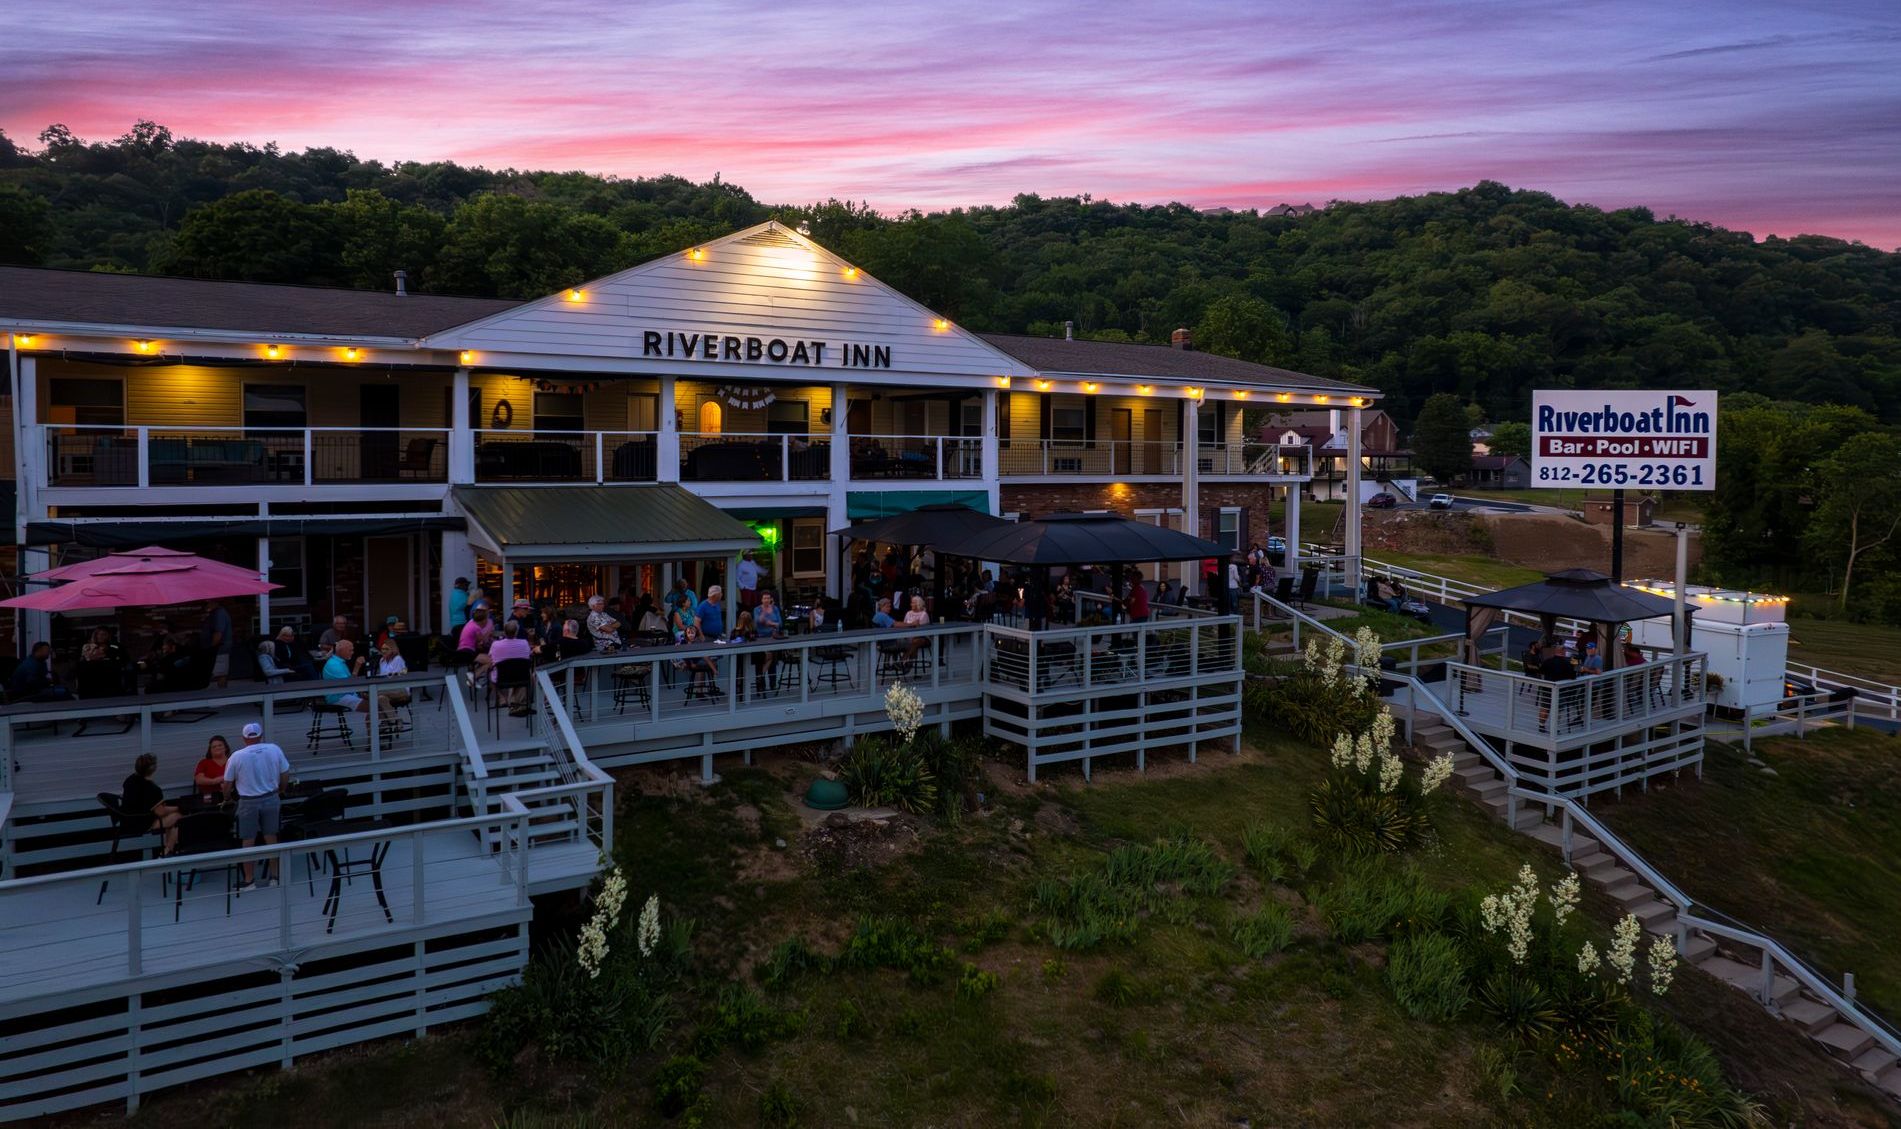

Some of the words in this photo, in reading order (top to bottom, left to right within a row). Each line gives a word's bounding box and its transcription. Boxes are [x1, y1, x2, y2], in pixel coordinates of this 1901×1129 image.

[643, 330, 826, 365] RIVERBOAT
[842, 343, 891, 368] INN
[1539, 404, 1664, 433] Riverboat
[1667, 395, 1710, 434] Inn
[1652, 439, 1698, 455] WIFI
[1539, 463, 1703, 485] 812-265-2361
